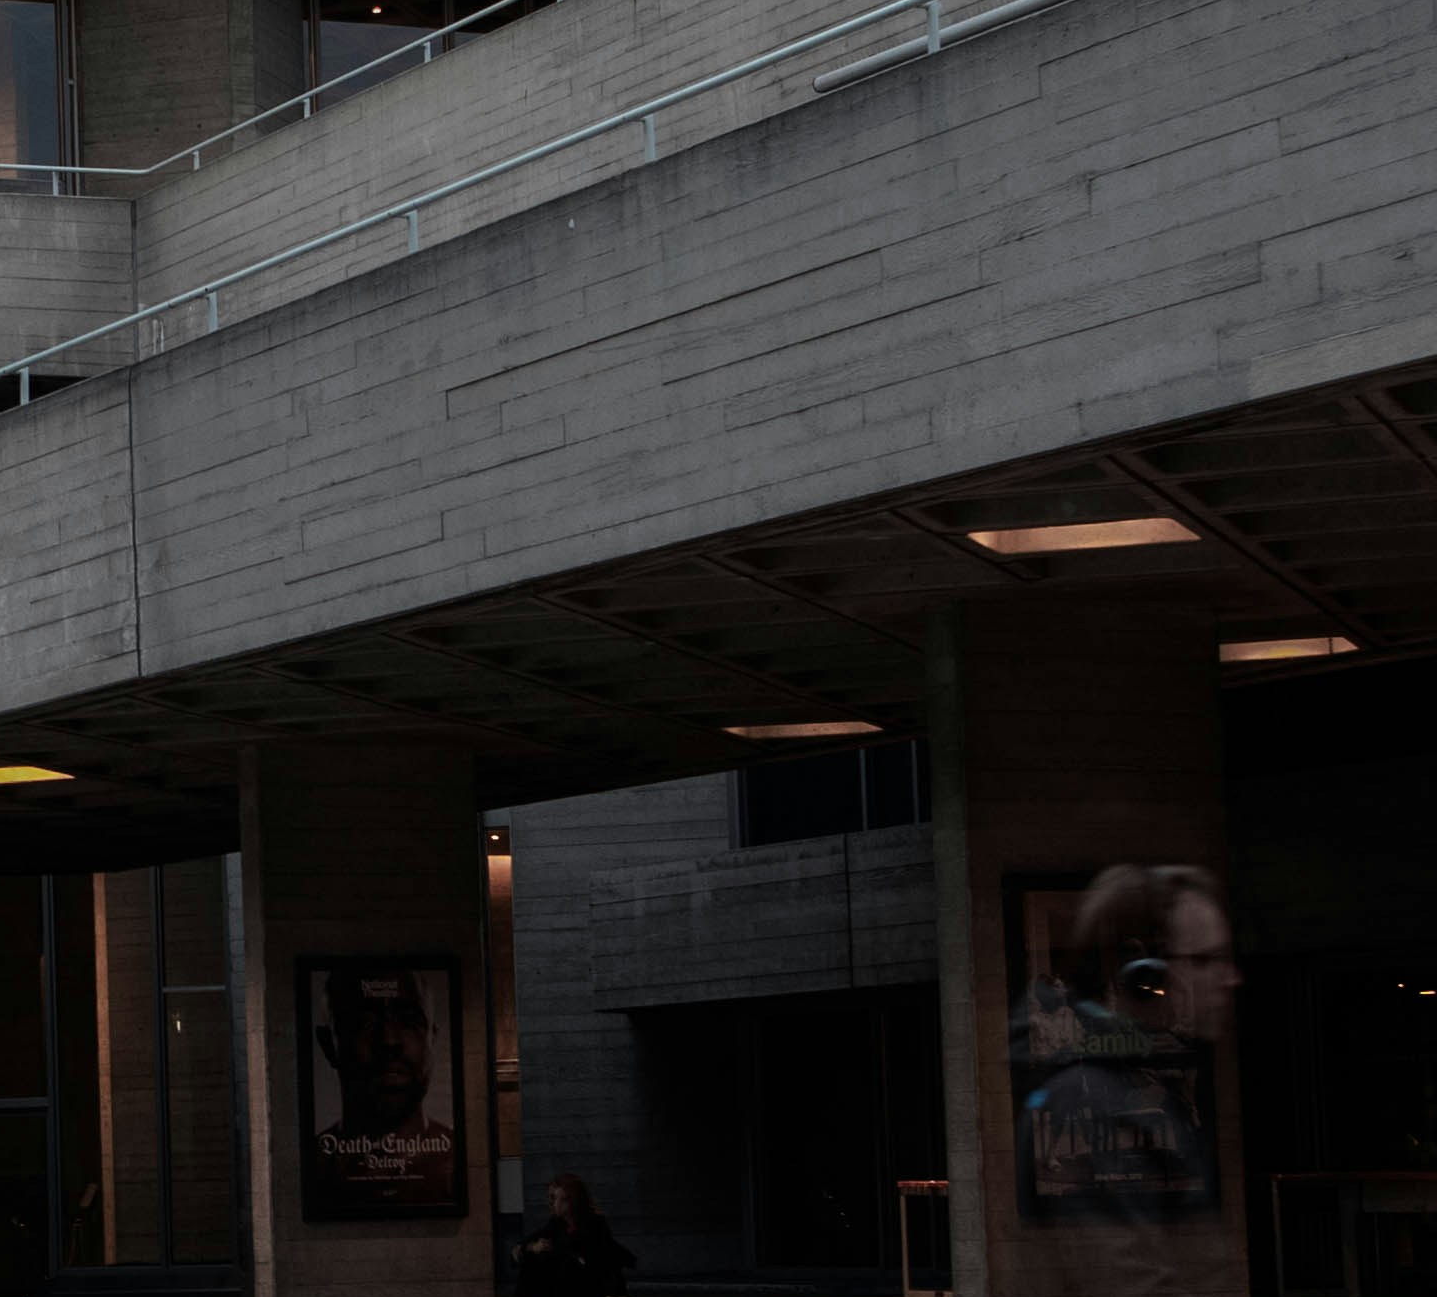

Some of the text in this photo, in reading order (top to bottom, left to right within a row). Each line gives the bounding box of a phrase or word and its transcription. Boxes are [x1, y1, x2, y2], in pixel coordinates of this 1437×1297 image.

[1073, 1024, 1151, 1056] amily
[319, 1133, 372, 1155] Death
[381, 1132, 452, 1157] England
